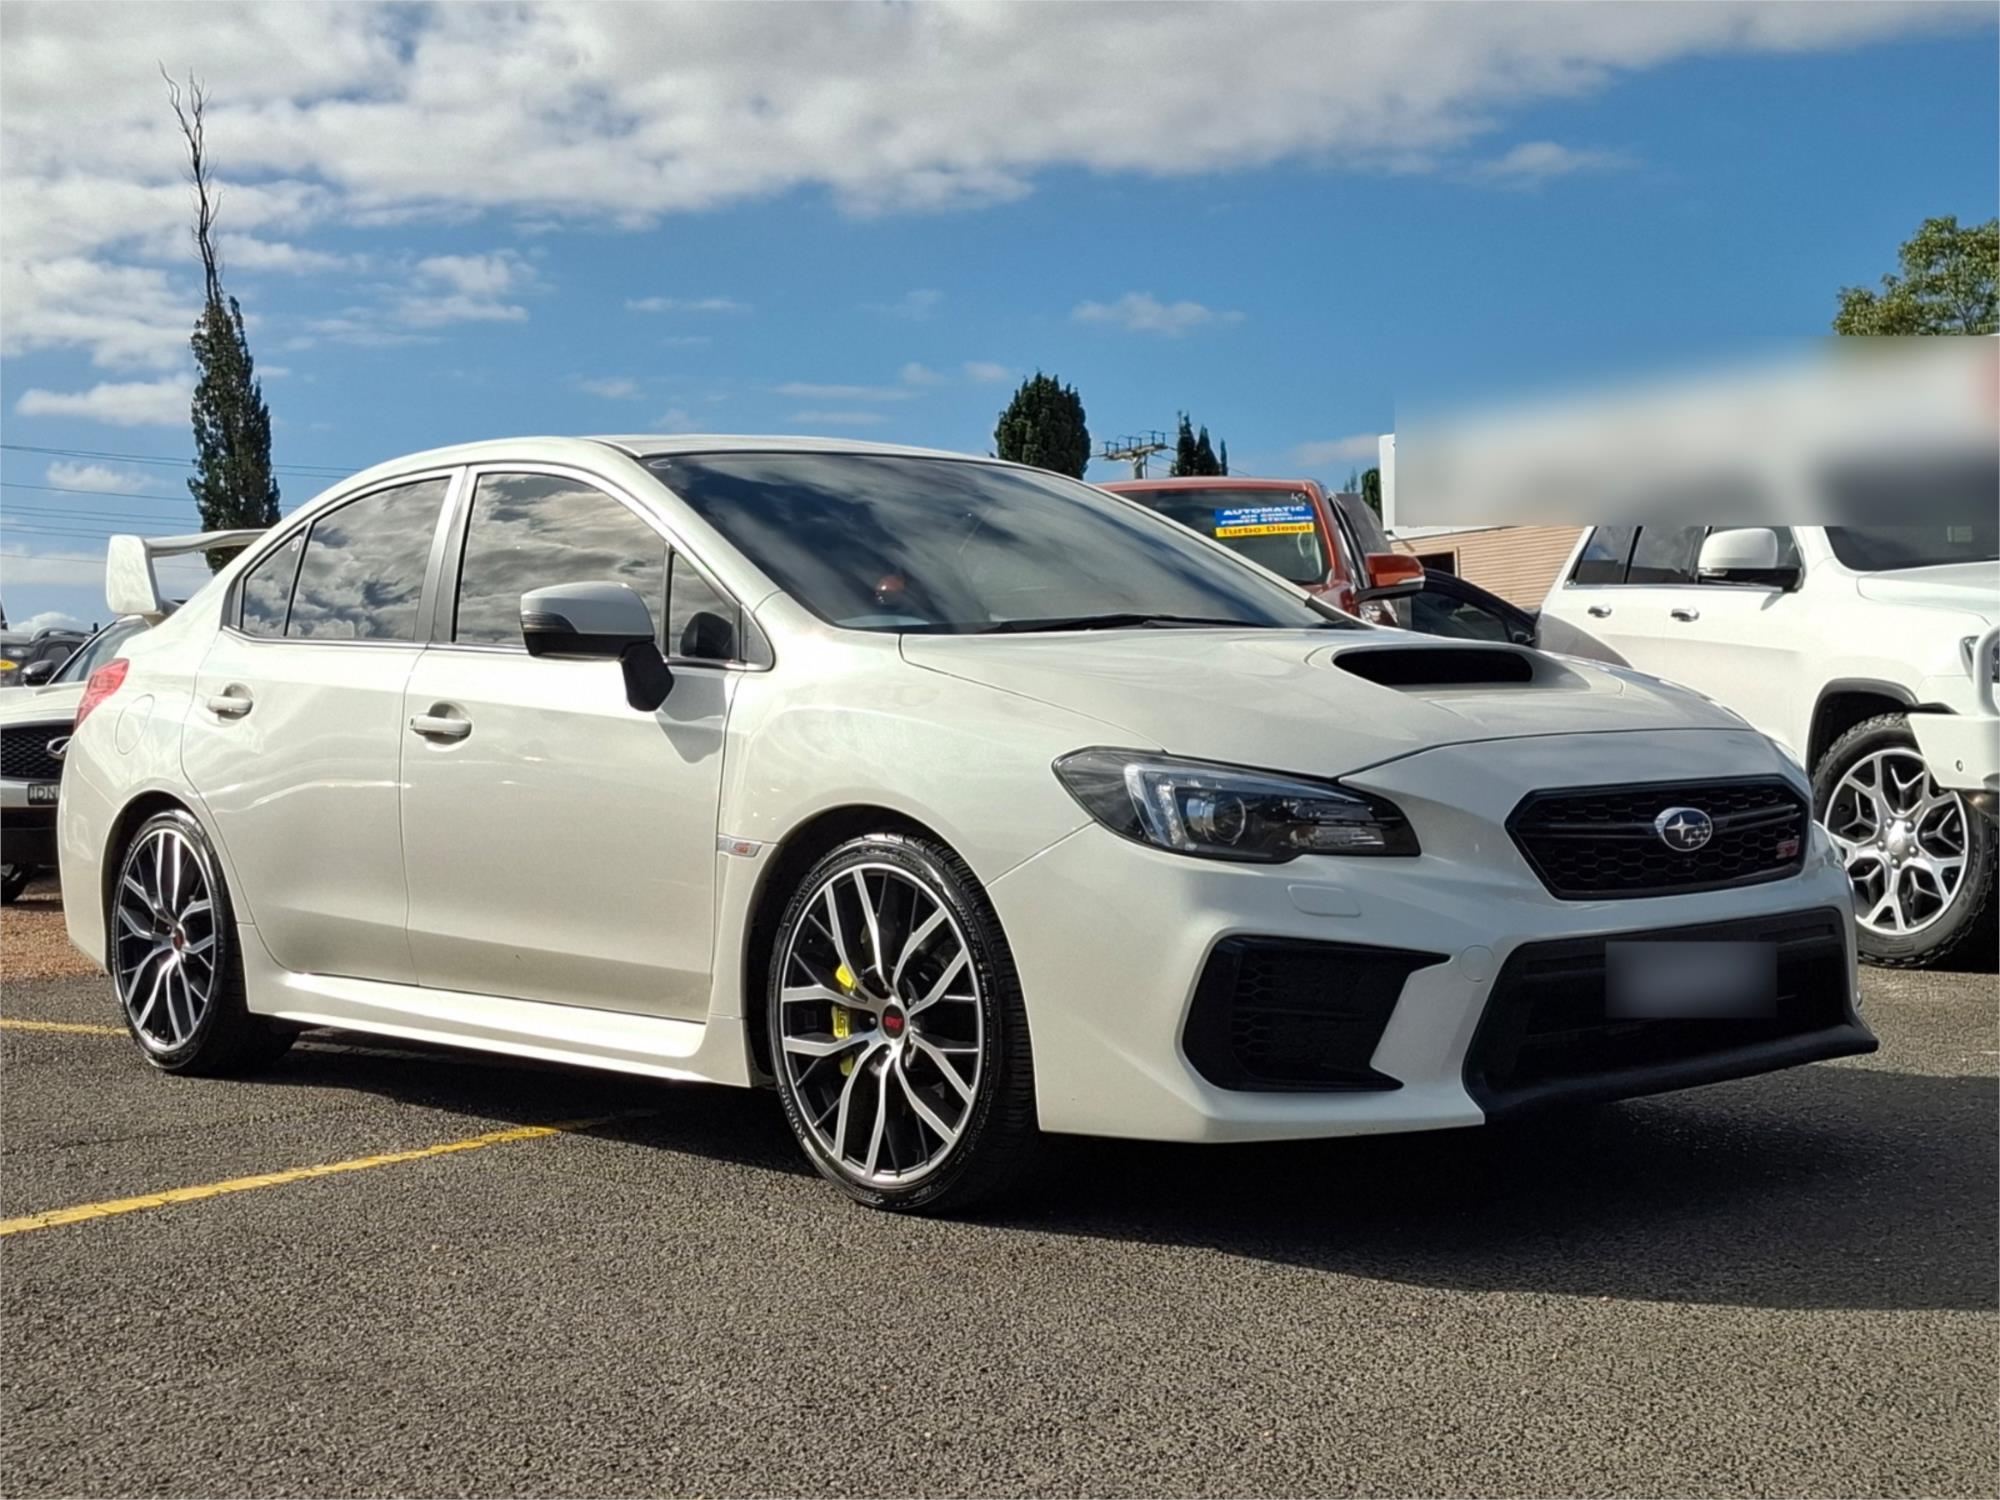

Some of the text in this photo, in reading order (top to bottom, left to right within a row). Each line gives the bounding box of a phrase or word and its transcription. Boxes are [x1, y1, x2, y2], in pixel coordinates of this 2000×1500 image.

[1223, 506, 1305, 516] AUTOMATIC
[1222, 524, 1311, 535] Turbo Diesel
